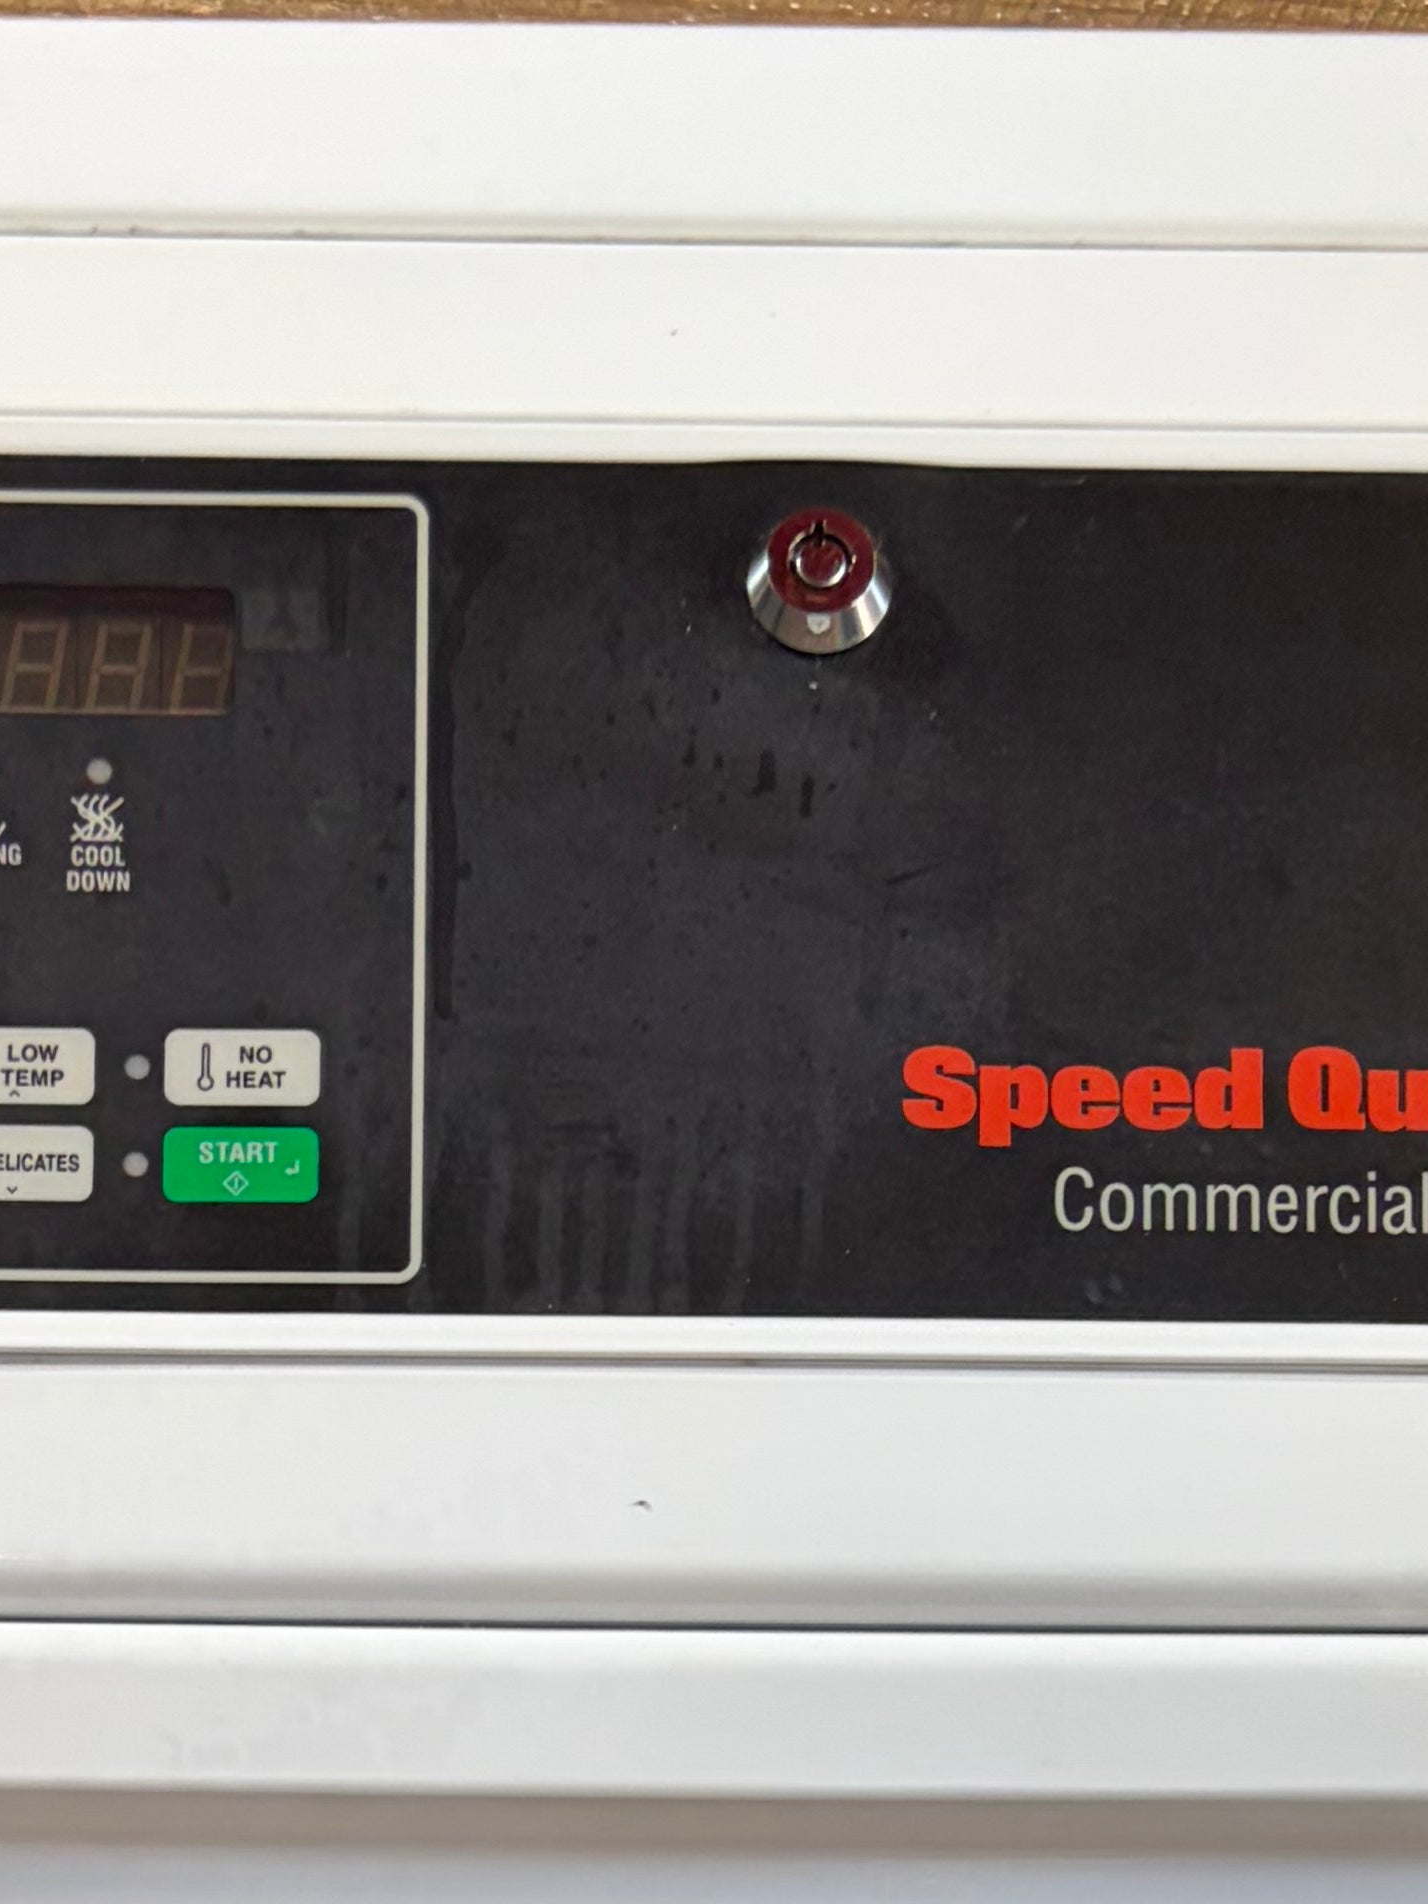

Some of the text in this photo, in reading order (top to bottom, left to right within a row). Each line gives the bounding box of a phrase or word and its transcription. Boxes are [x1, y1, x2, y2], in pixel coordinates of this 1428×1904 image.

[71, 845, 125, 866] COOL
[67, 870, 130, 892] DOWN
[8, 1044, 58, 1062] LOW
[240, 1046, 272, 1064] NO
[1, 1069, 64, 1086] TEMP
[226, 1071, 286, 1088] HEAT
[902, 1046, 1263, 1147] Speed
[200, 1142, 278, 1164] START
